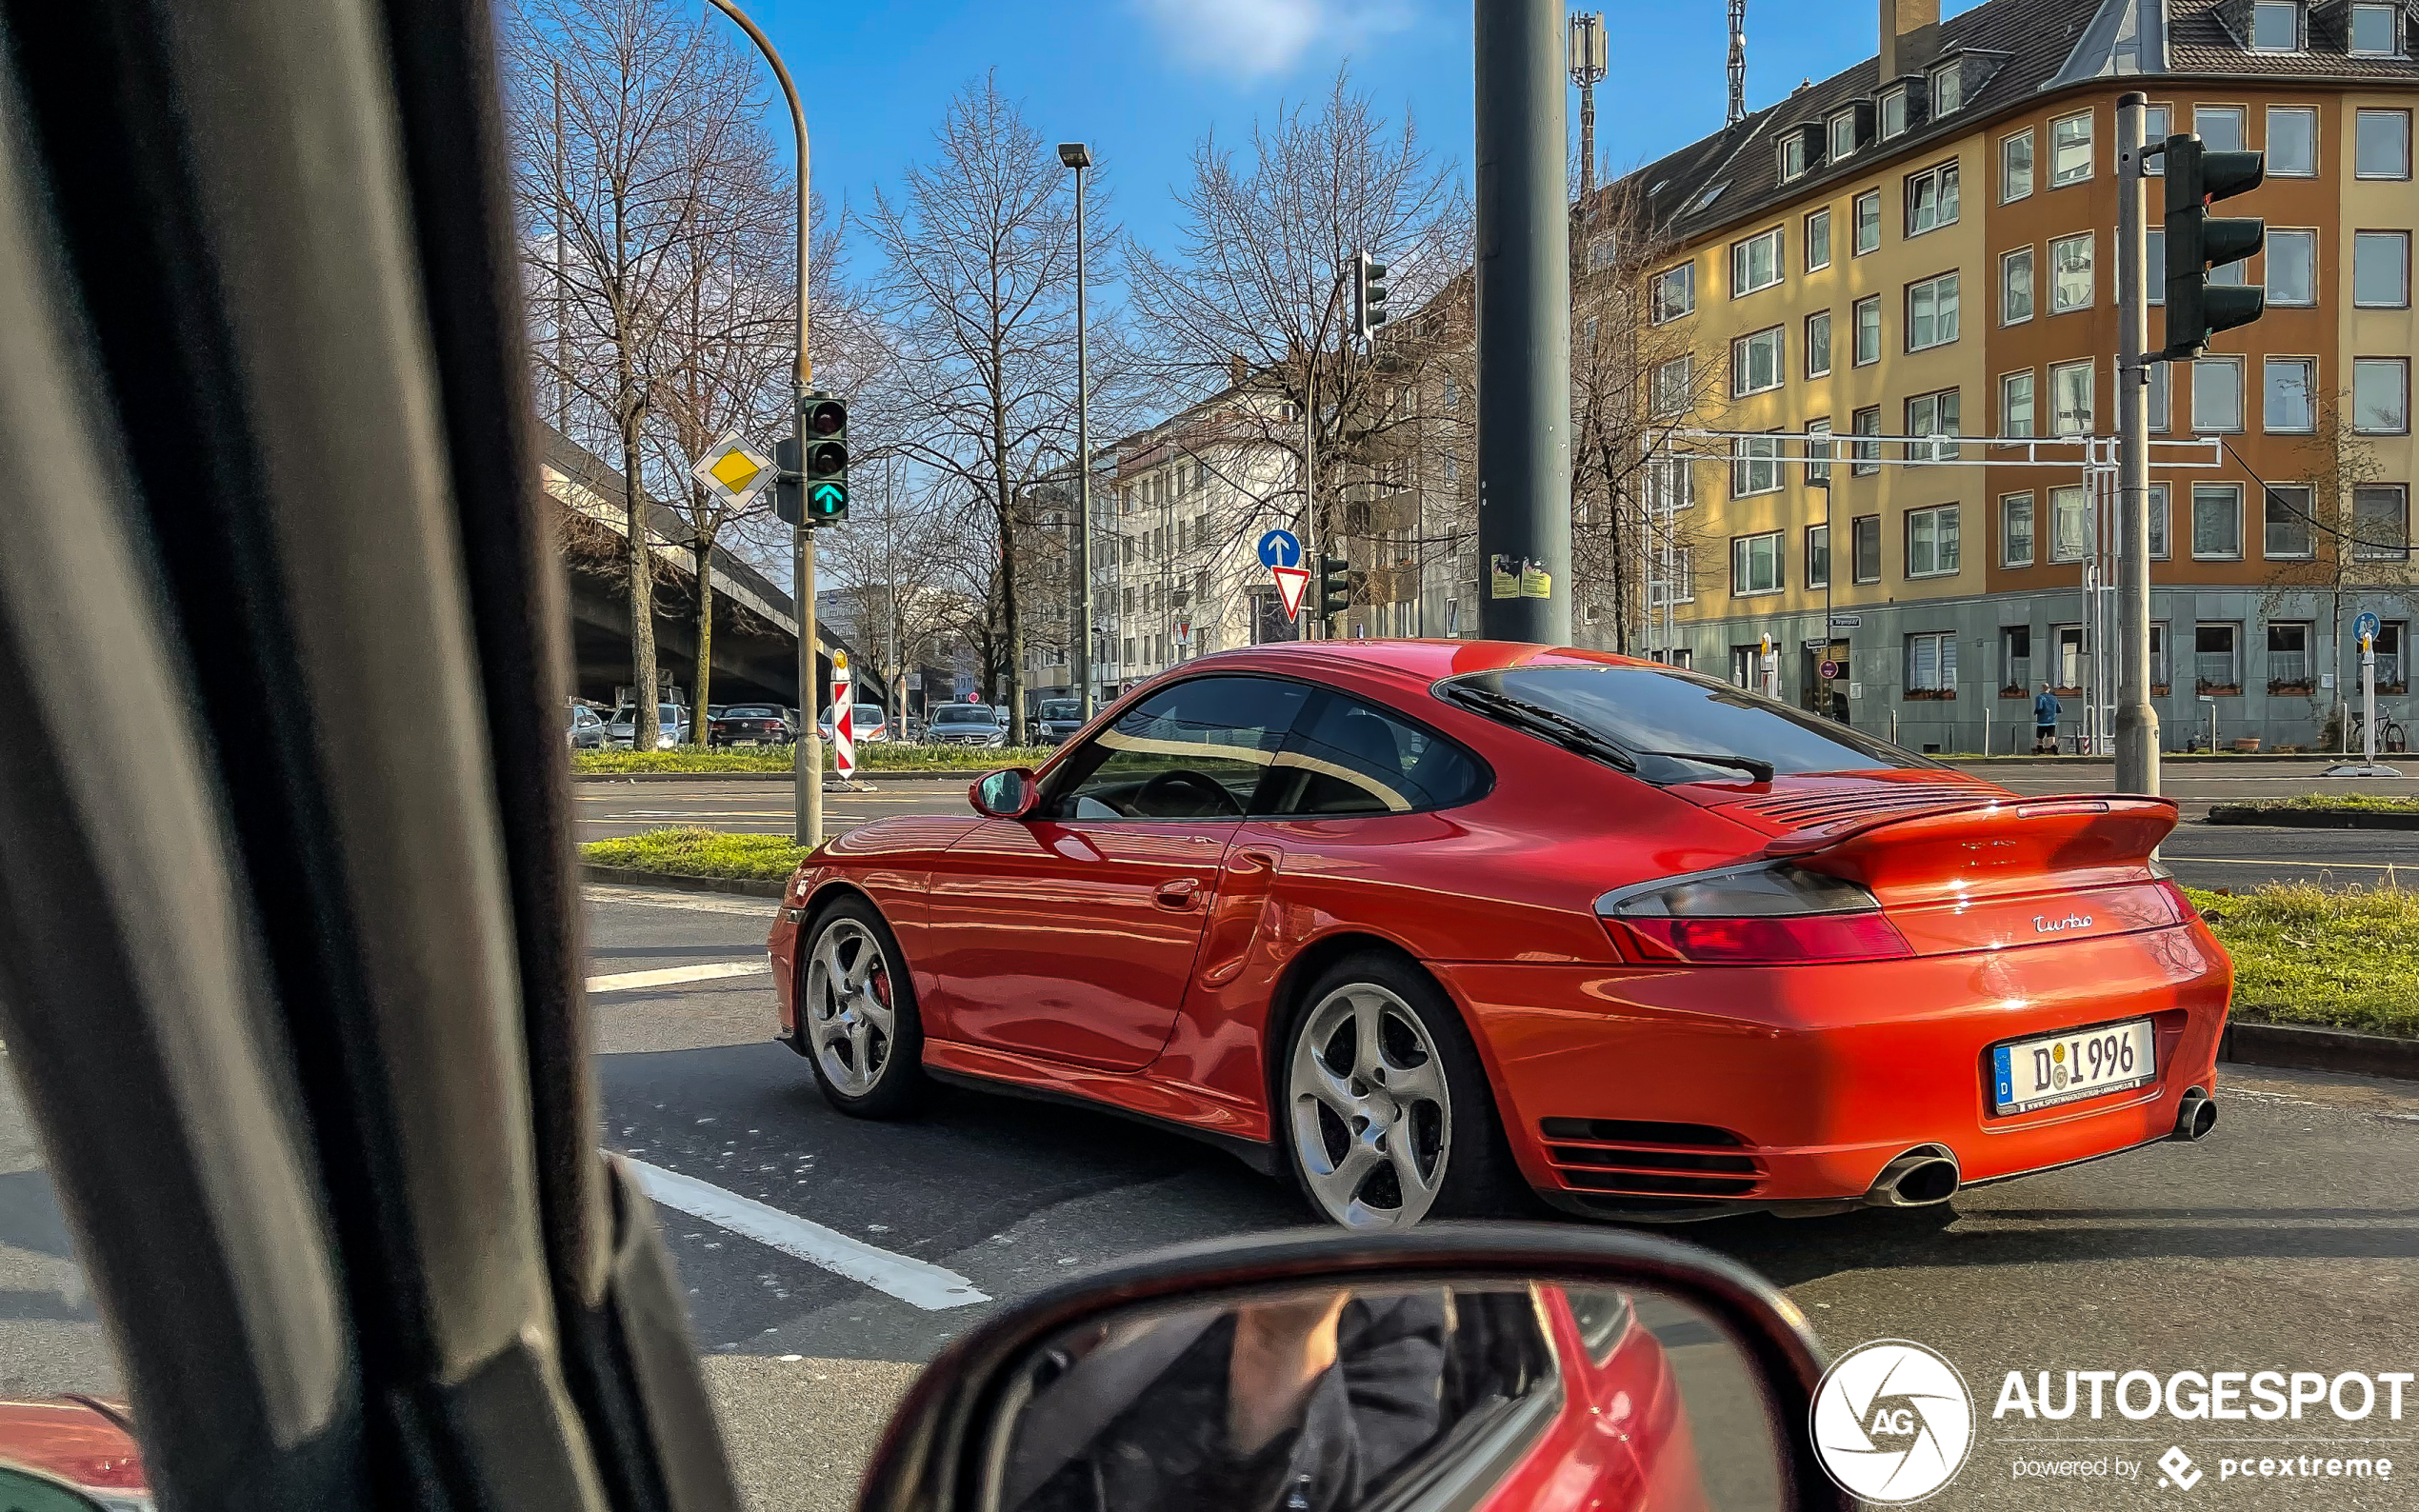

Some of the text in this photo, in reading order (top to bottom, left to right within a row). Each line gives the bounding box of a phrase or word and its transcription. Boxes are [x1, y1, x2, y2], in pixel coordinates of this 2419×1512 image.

[2031, 913, 2092, 933] Turbo
[2034, 1047, 2051, 1091] D
[2000, 1082, 2009, 1095] D
